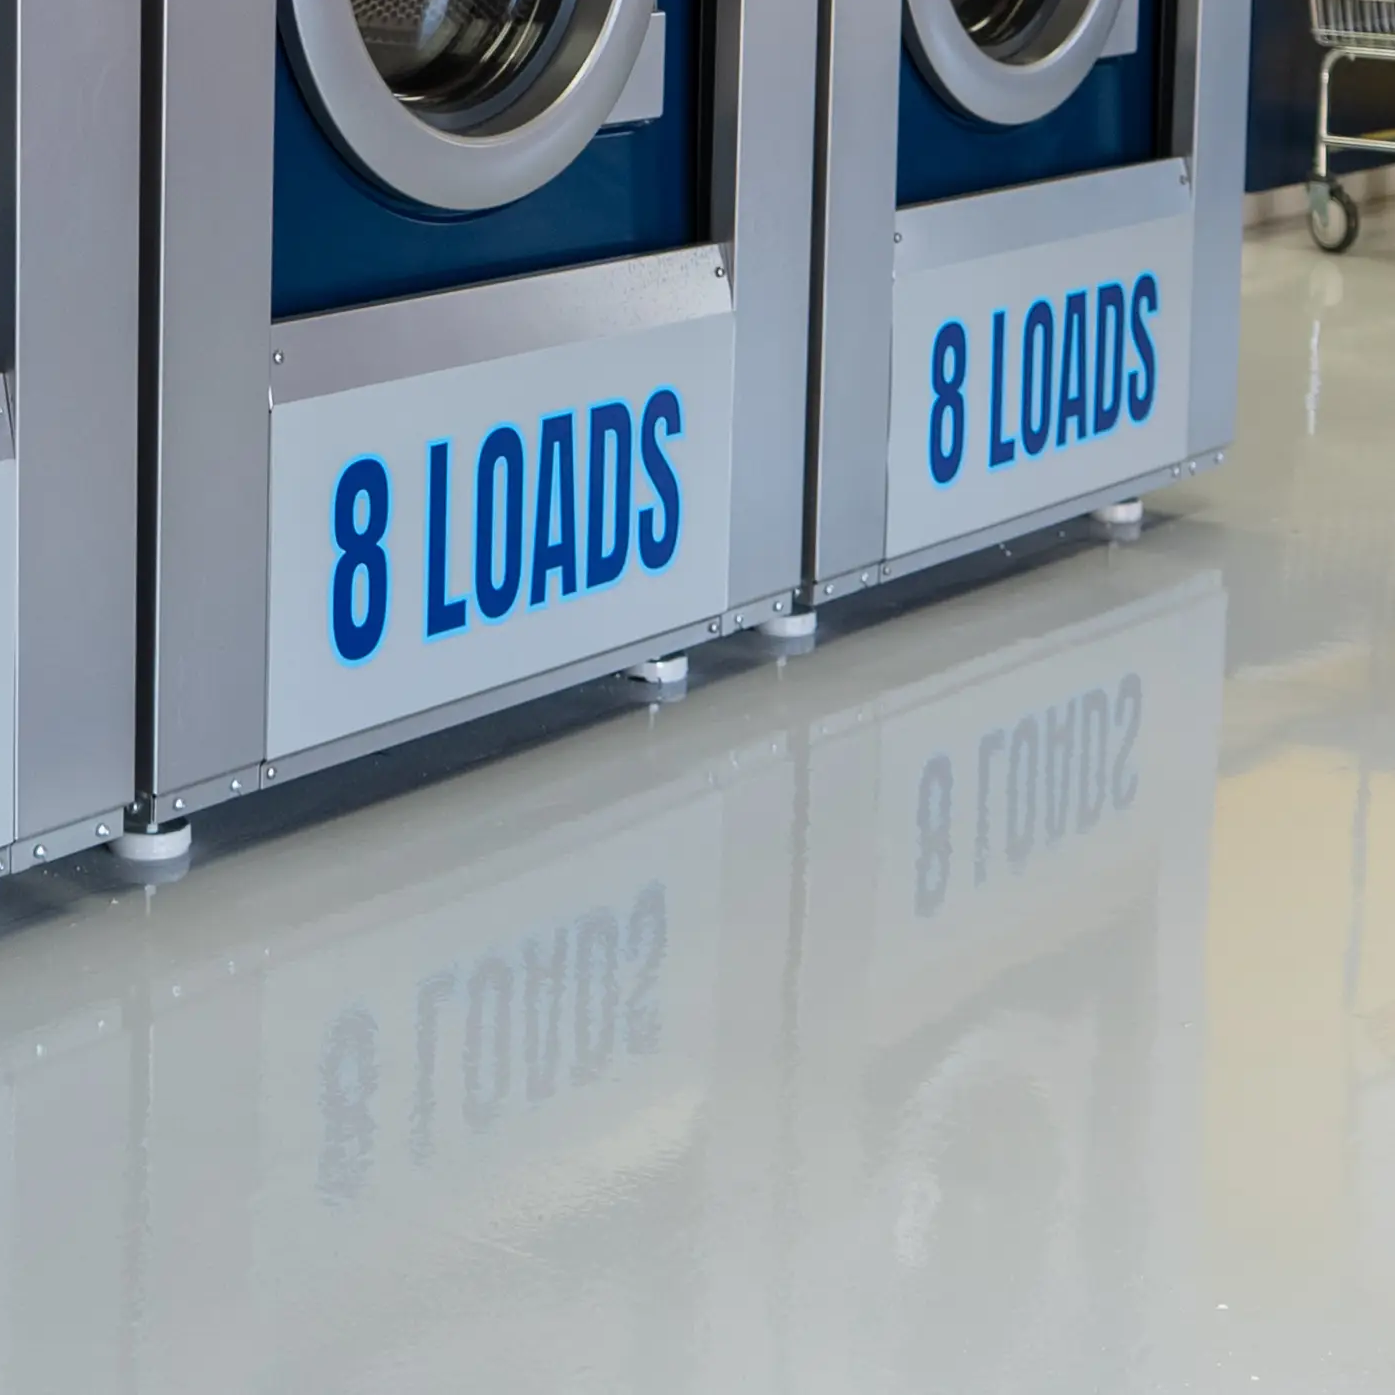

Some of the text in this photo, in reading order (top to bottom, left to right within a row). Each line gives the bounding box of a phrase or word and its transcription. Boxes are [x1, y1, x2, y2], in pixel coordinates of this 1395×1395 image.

[928, 270, 1159, 487] 8 LOADS
[329, 384, 684, 667] 8 LOADS
